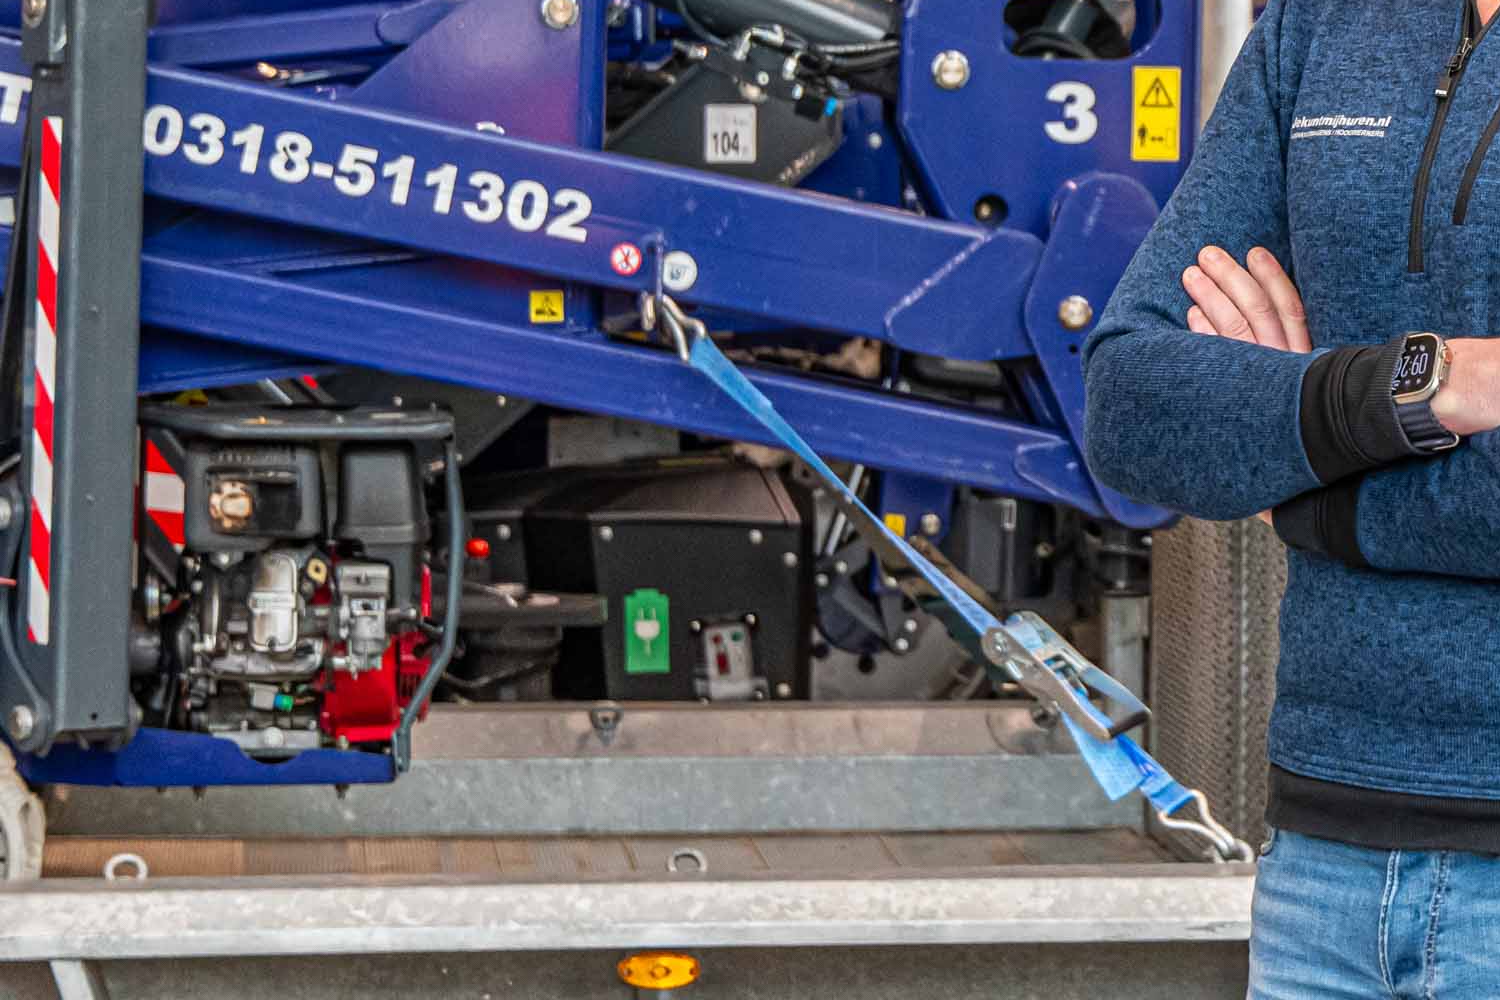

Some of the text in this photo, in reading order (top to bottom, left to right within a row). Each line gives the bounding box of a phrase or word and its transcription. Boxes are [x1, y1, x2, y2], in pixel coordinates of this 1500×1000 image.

[712, 131, 740, 155] 104
[1044, 81, 1099, 145] 3
[143, 105, 593, 243] 0318-511302
